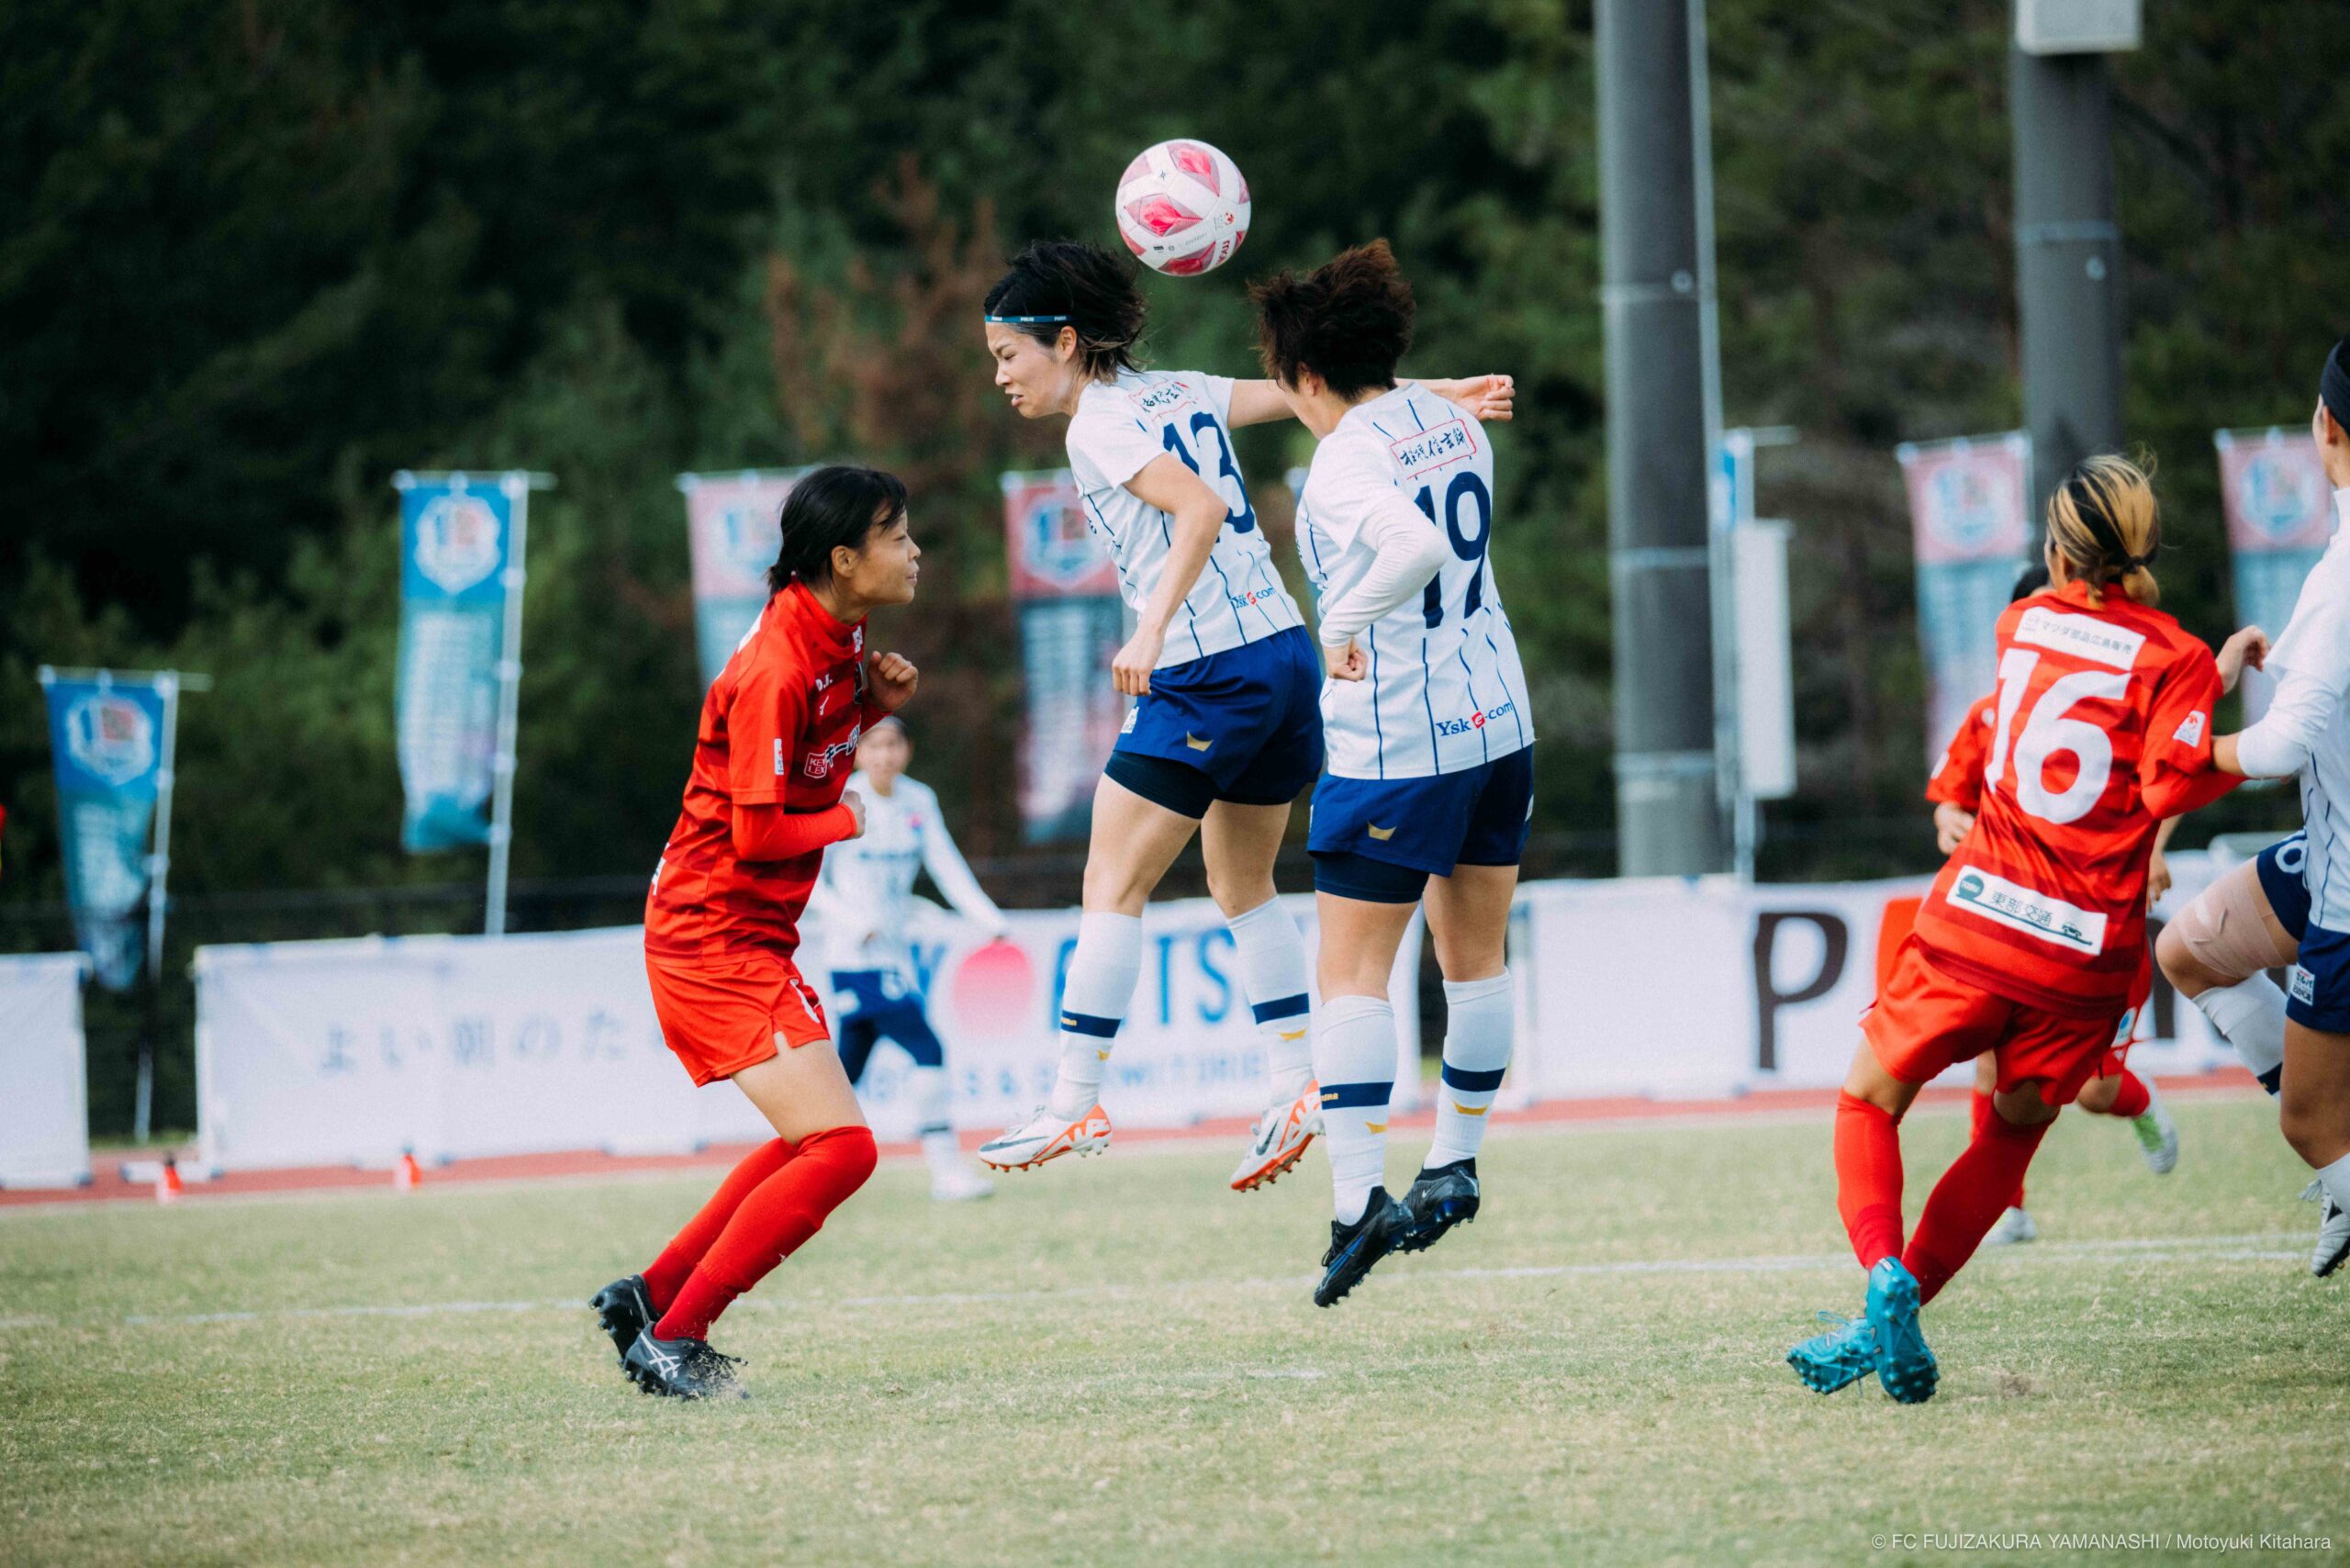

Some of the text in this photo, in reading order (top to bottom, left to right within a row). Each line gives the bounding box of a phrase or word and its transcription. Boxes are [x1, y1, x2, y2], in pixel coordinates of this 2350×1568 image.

[1415, 471, 1492, 629] 19
[1984, 648, 2131, 824] 16
[1991, 890, 2053, 927] 東部交通
